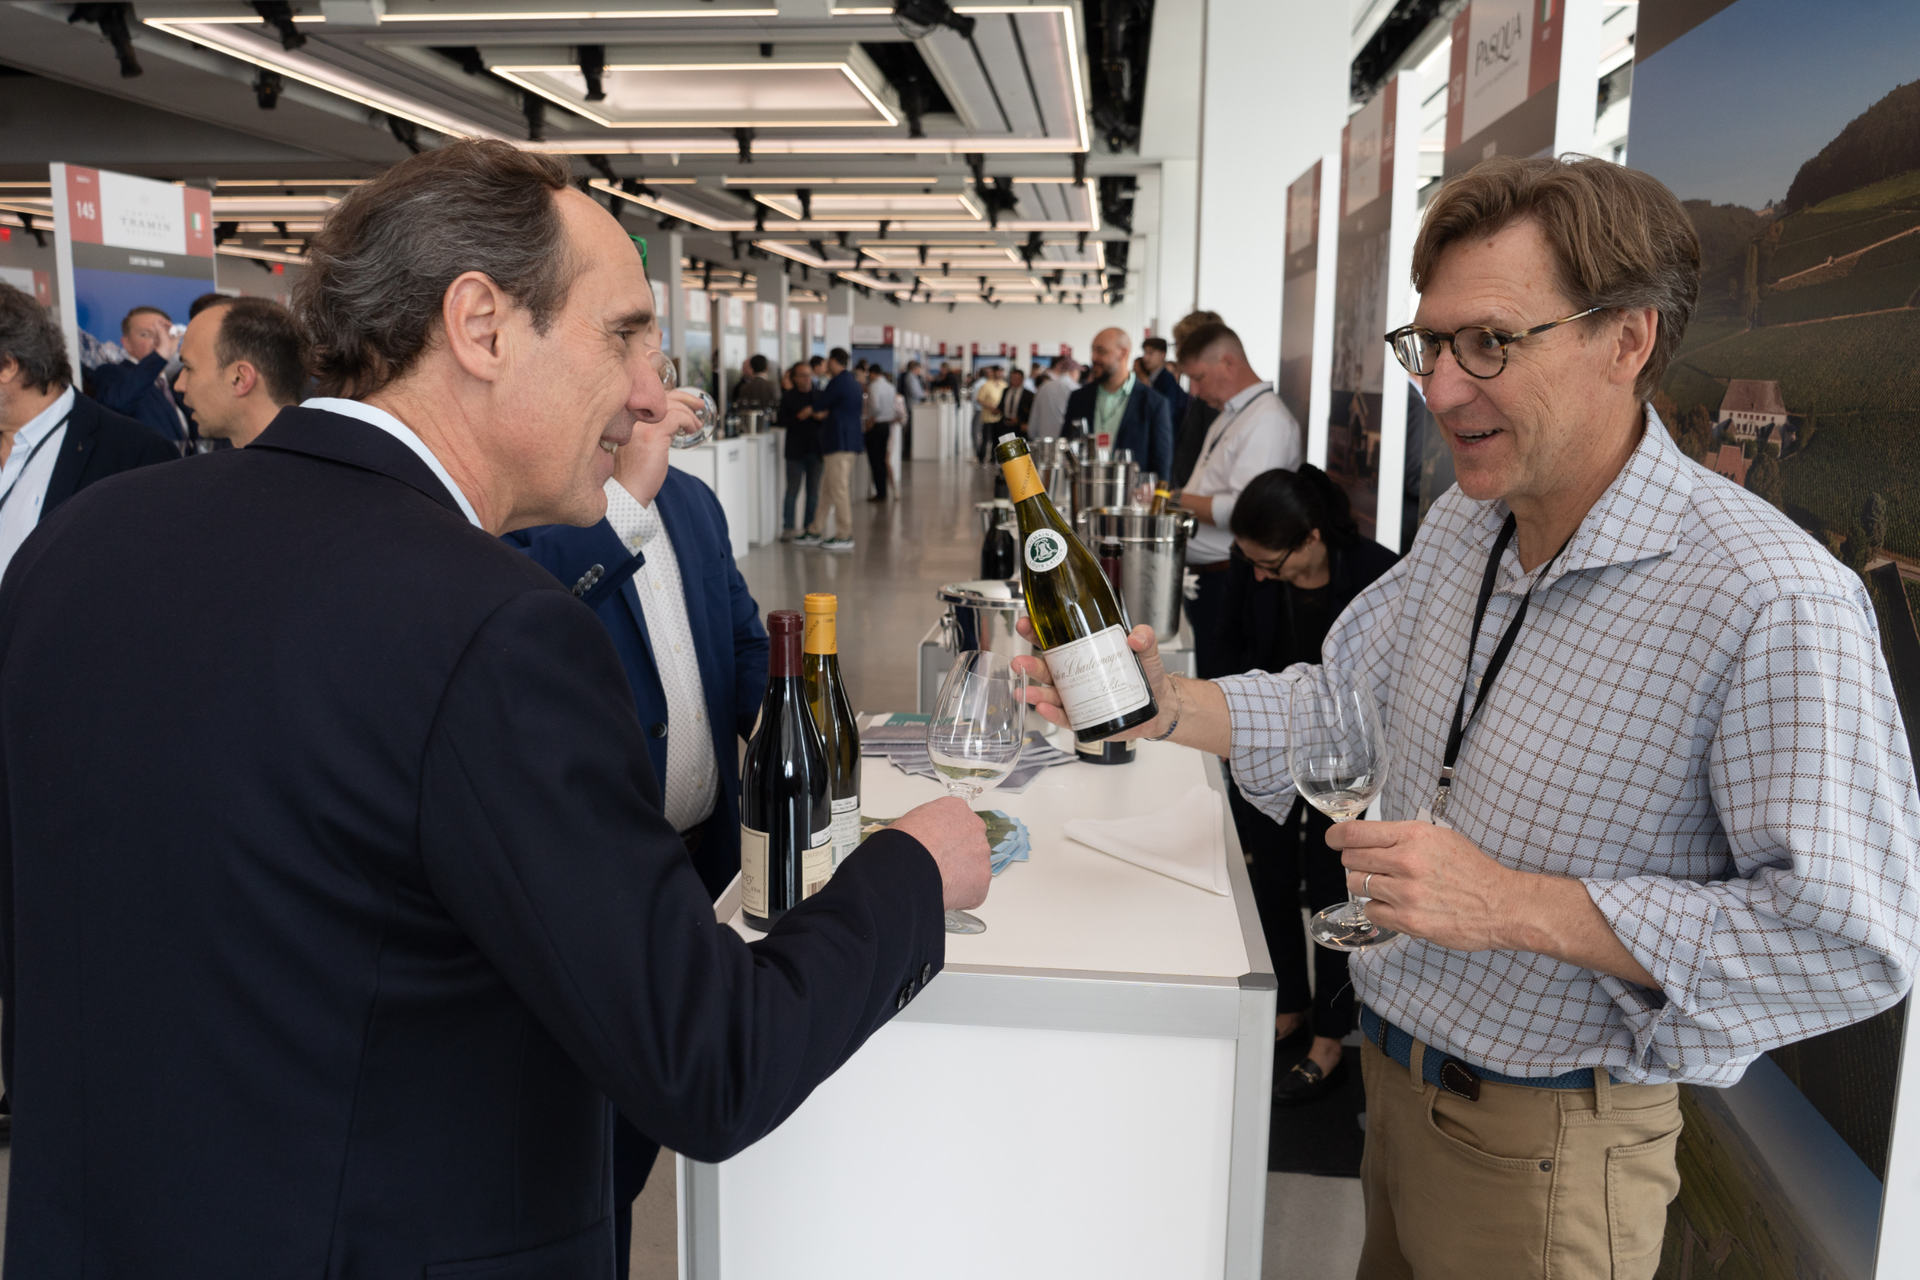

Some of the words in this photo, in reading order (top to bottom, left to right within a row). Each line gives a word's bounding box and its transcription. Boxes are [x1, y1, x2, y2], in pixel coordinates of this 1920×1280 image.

[1474, 12, 1522, 76] PASQUA
[76, 200, 96, 220] 145
[1027, 532, 1054, 549] DOMAINE
[1028, 560, 1045, 569] LOUIS
[1046, 548, 1064, 568] LATOUR
